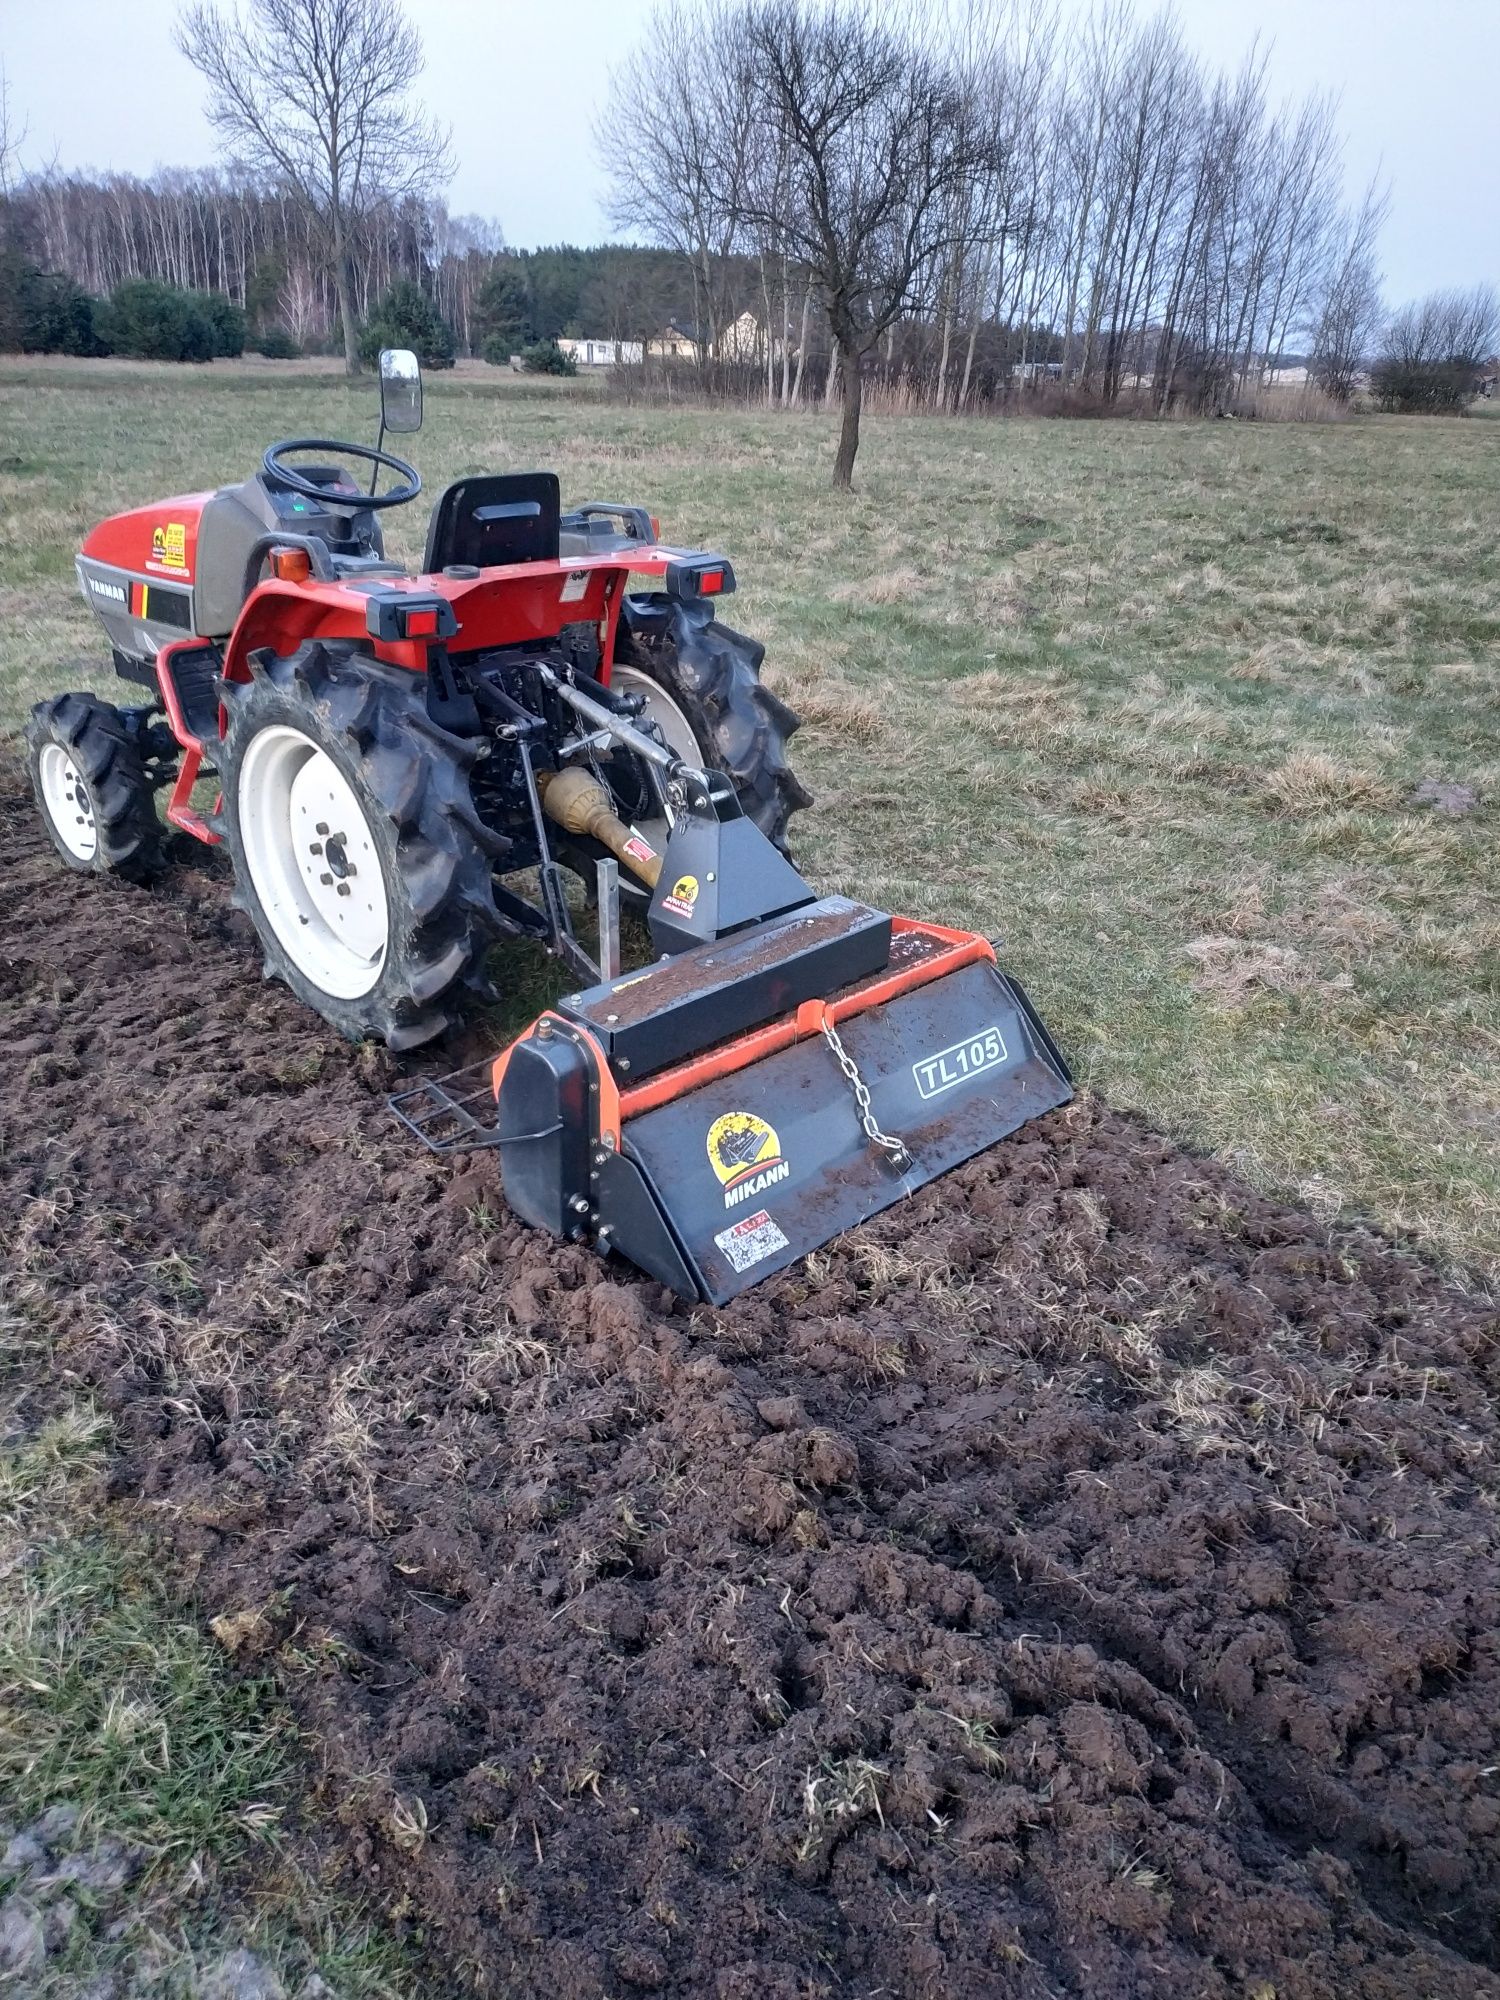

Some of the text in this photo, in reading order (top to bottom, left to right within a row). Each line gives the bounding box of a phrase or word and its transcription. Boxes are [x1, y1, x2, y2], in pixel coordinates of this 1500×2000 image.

[88, 577, 126, 603] YANMAR
[921, 1034, 999, 1089] TL 105
[724, 1161, 790, 1209] MIKANN
